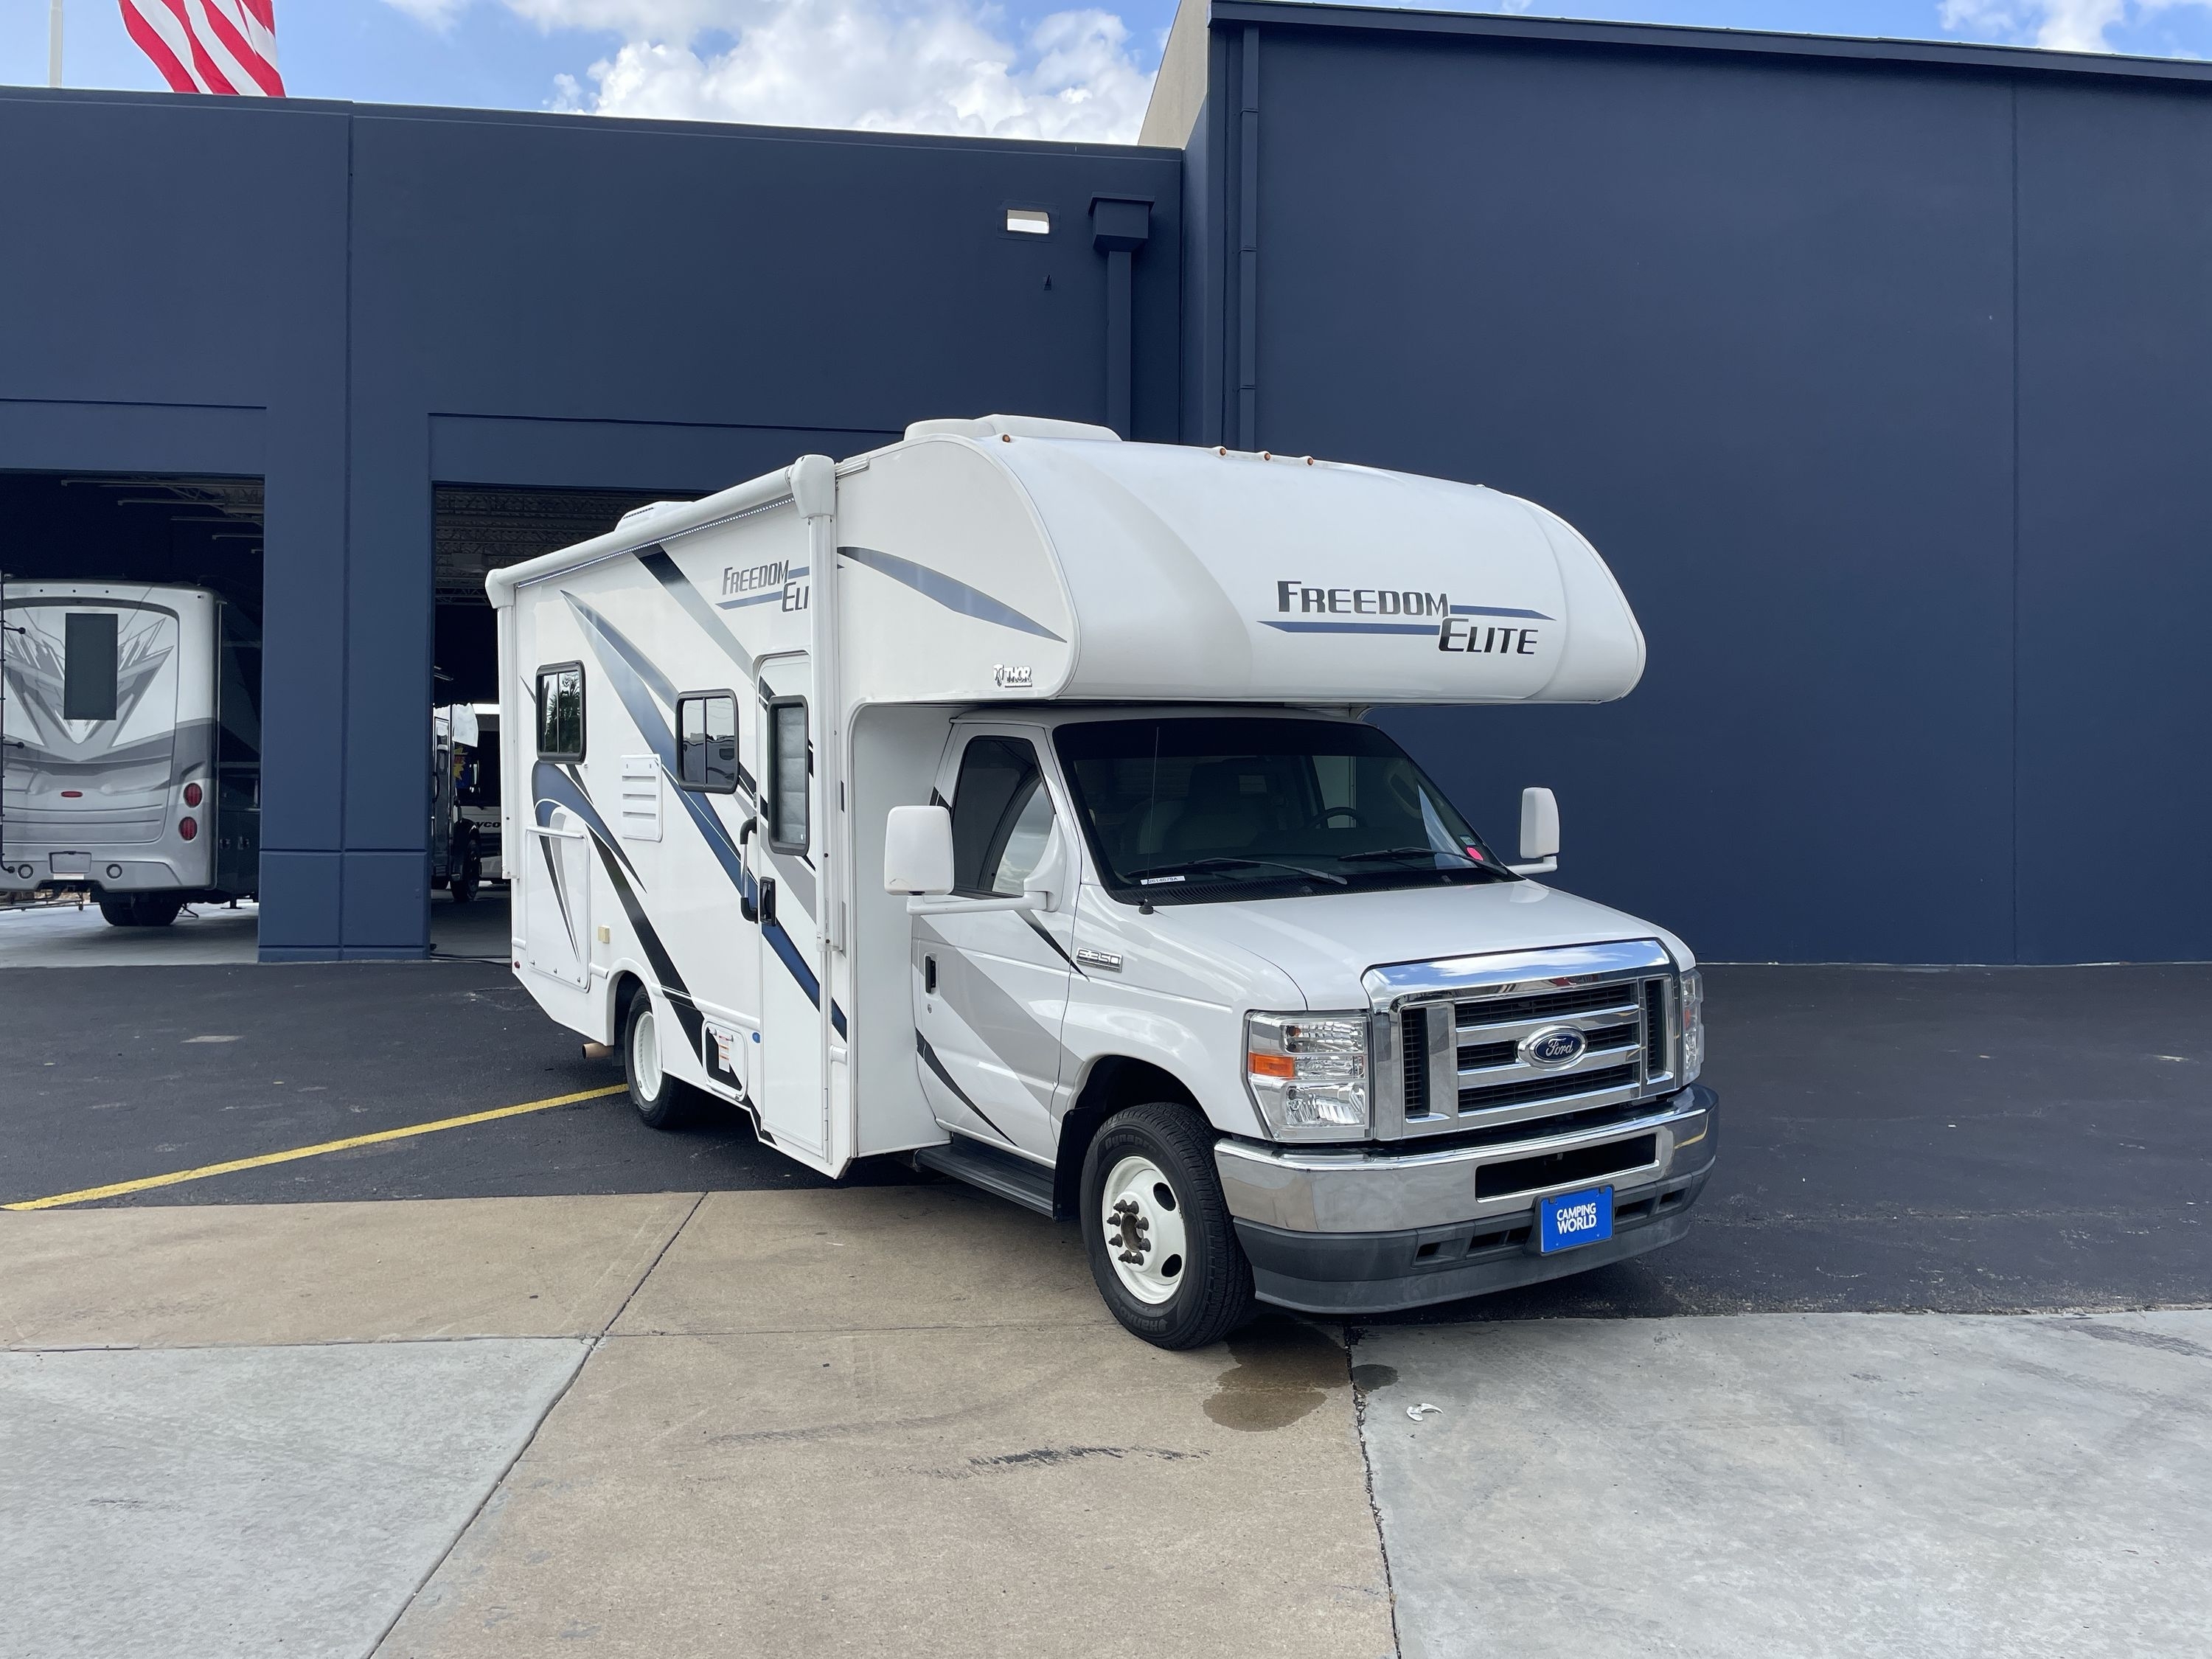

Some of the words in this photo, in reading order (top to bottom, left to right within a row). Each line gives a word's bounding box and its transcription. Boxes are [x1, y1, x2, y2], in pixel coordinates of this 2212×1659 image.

[722, 560, 789, 595] FREEDOM
[782, 581, 809, 613] ELI
[1277, 580, 1449, 617] FREEDOM
[1439, 618, 1539, 655] ELITE
[1004, 666, 1032, 683] THOR
[1545, 1037, 1573, 1057] Ford
[1557, 1203, 1596, 1221] CAMPING
[1557, 1214, 1597, 1234] WORLD
